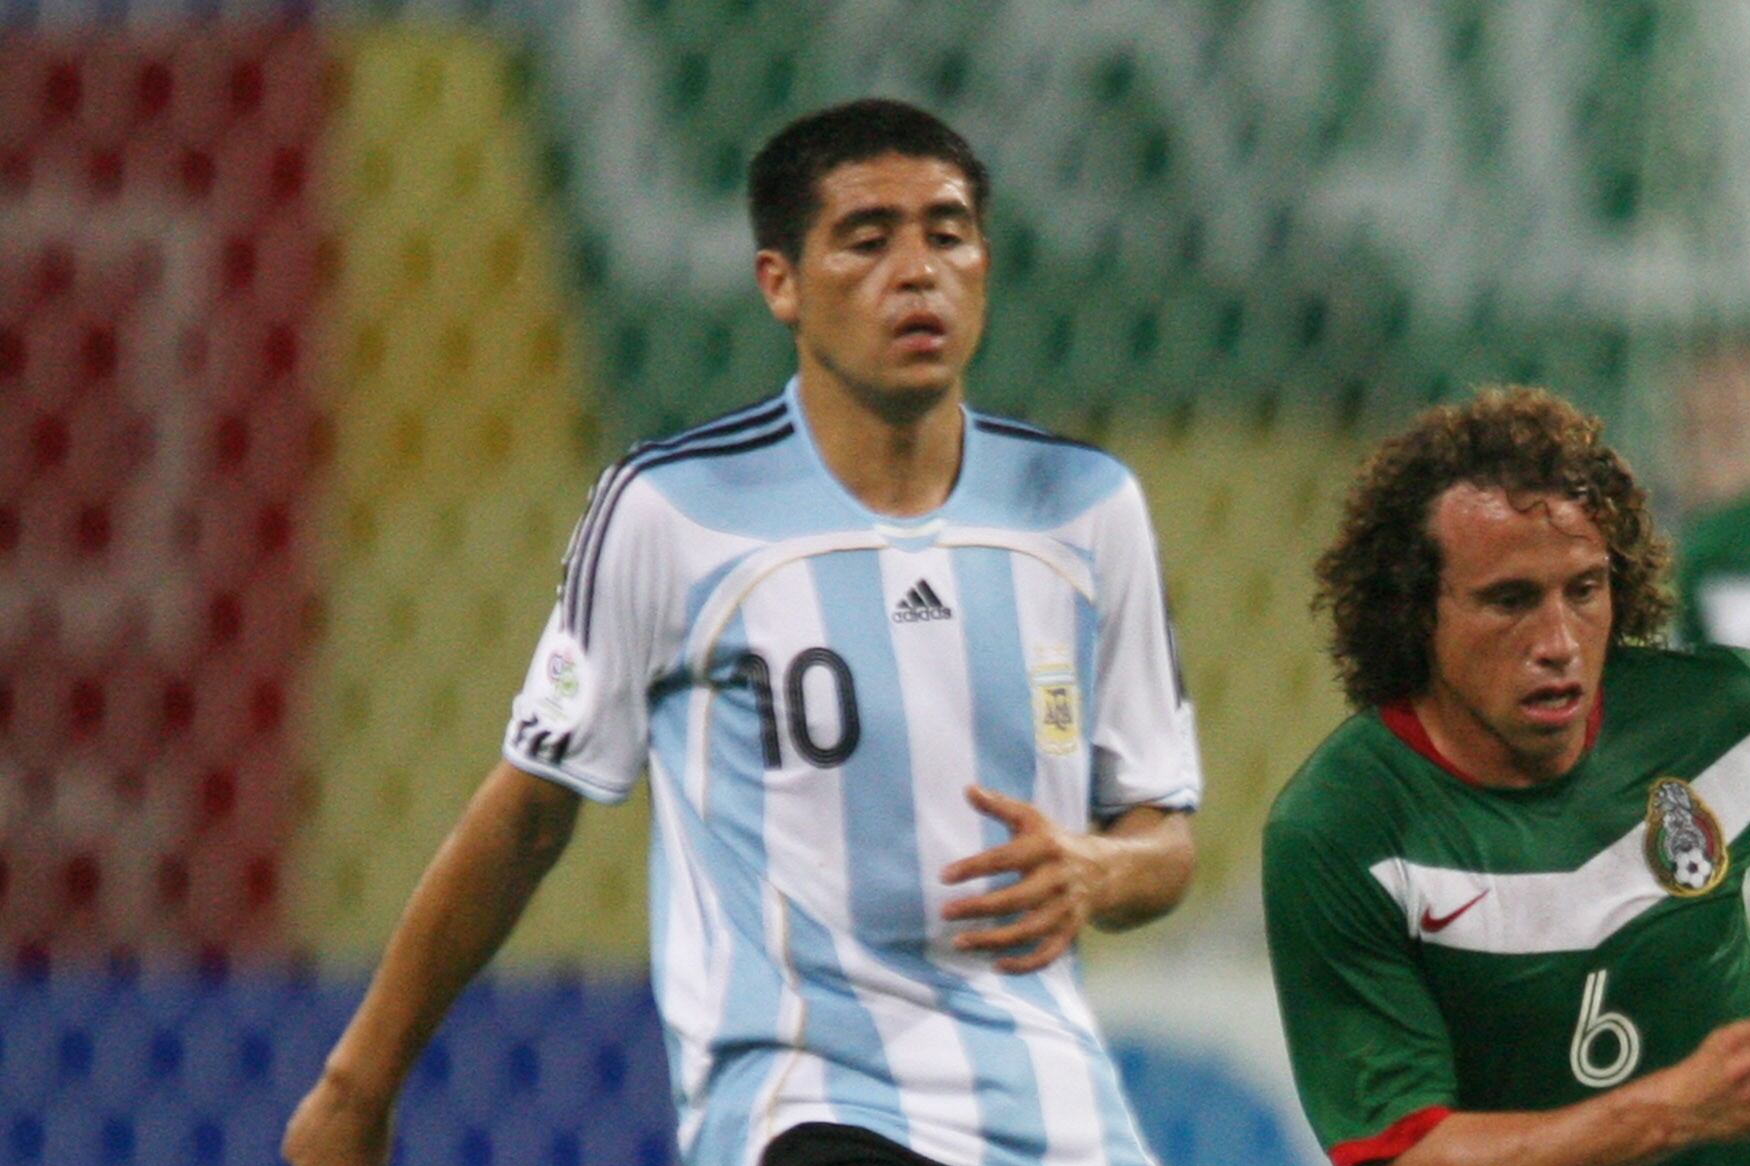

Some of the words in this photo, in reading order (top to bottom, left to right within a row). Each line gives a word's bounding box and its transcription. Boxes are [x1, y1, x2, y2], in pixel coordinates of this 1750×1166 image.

[892, 606, 953, 624] adidas
[722, 647, 861, 770] 10
[1569, 968, 1641, 1088] 6
